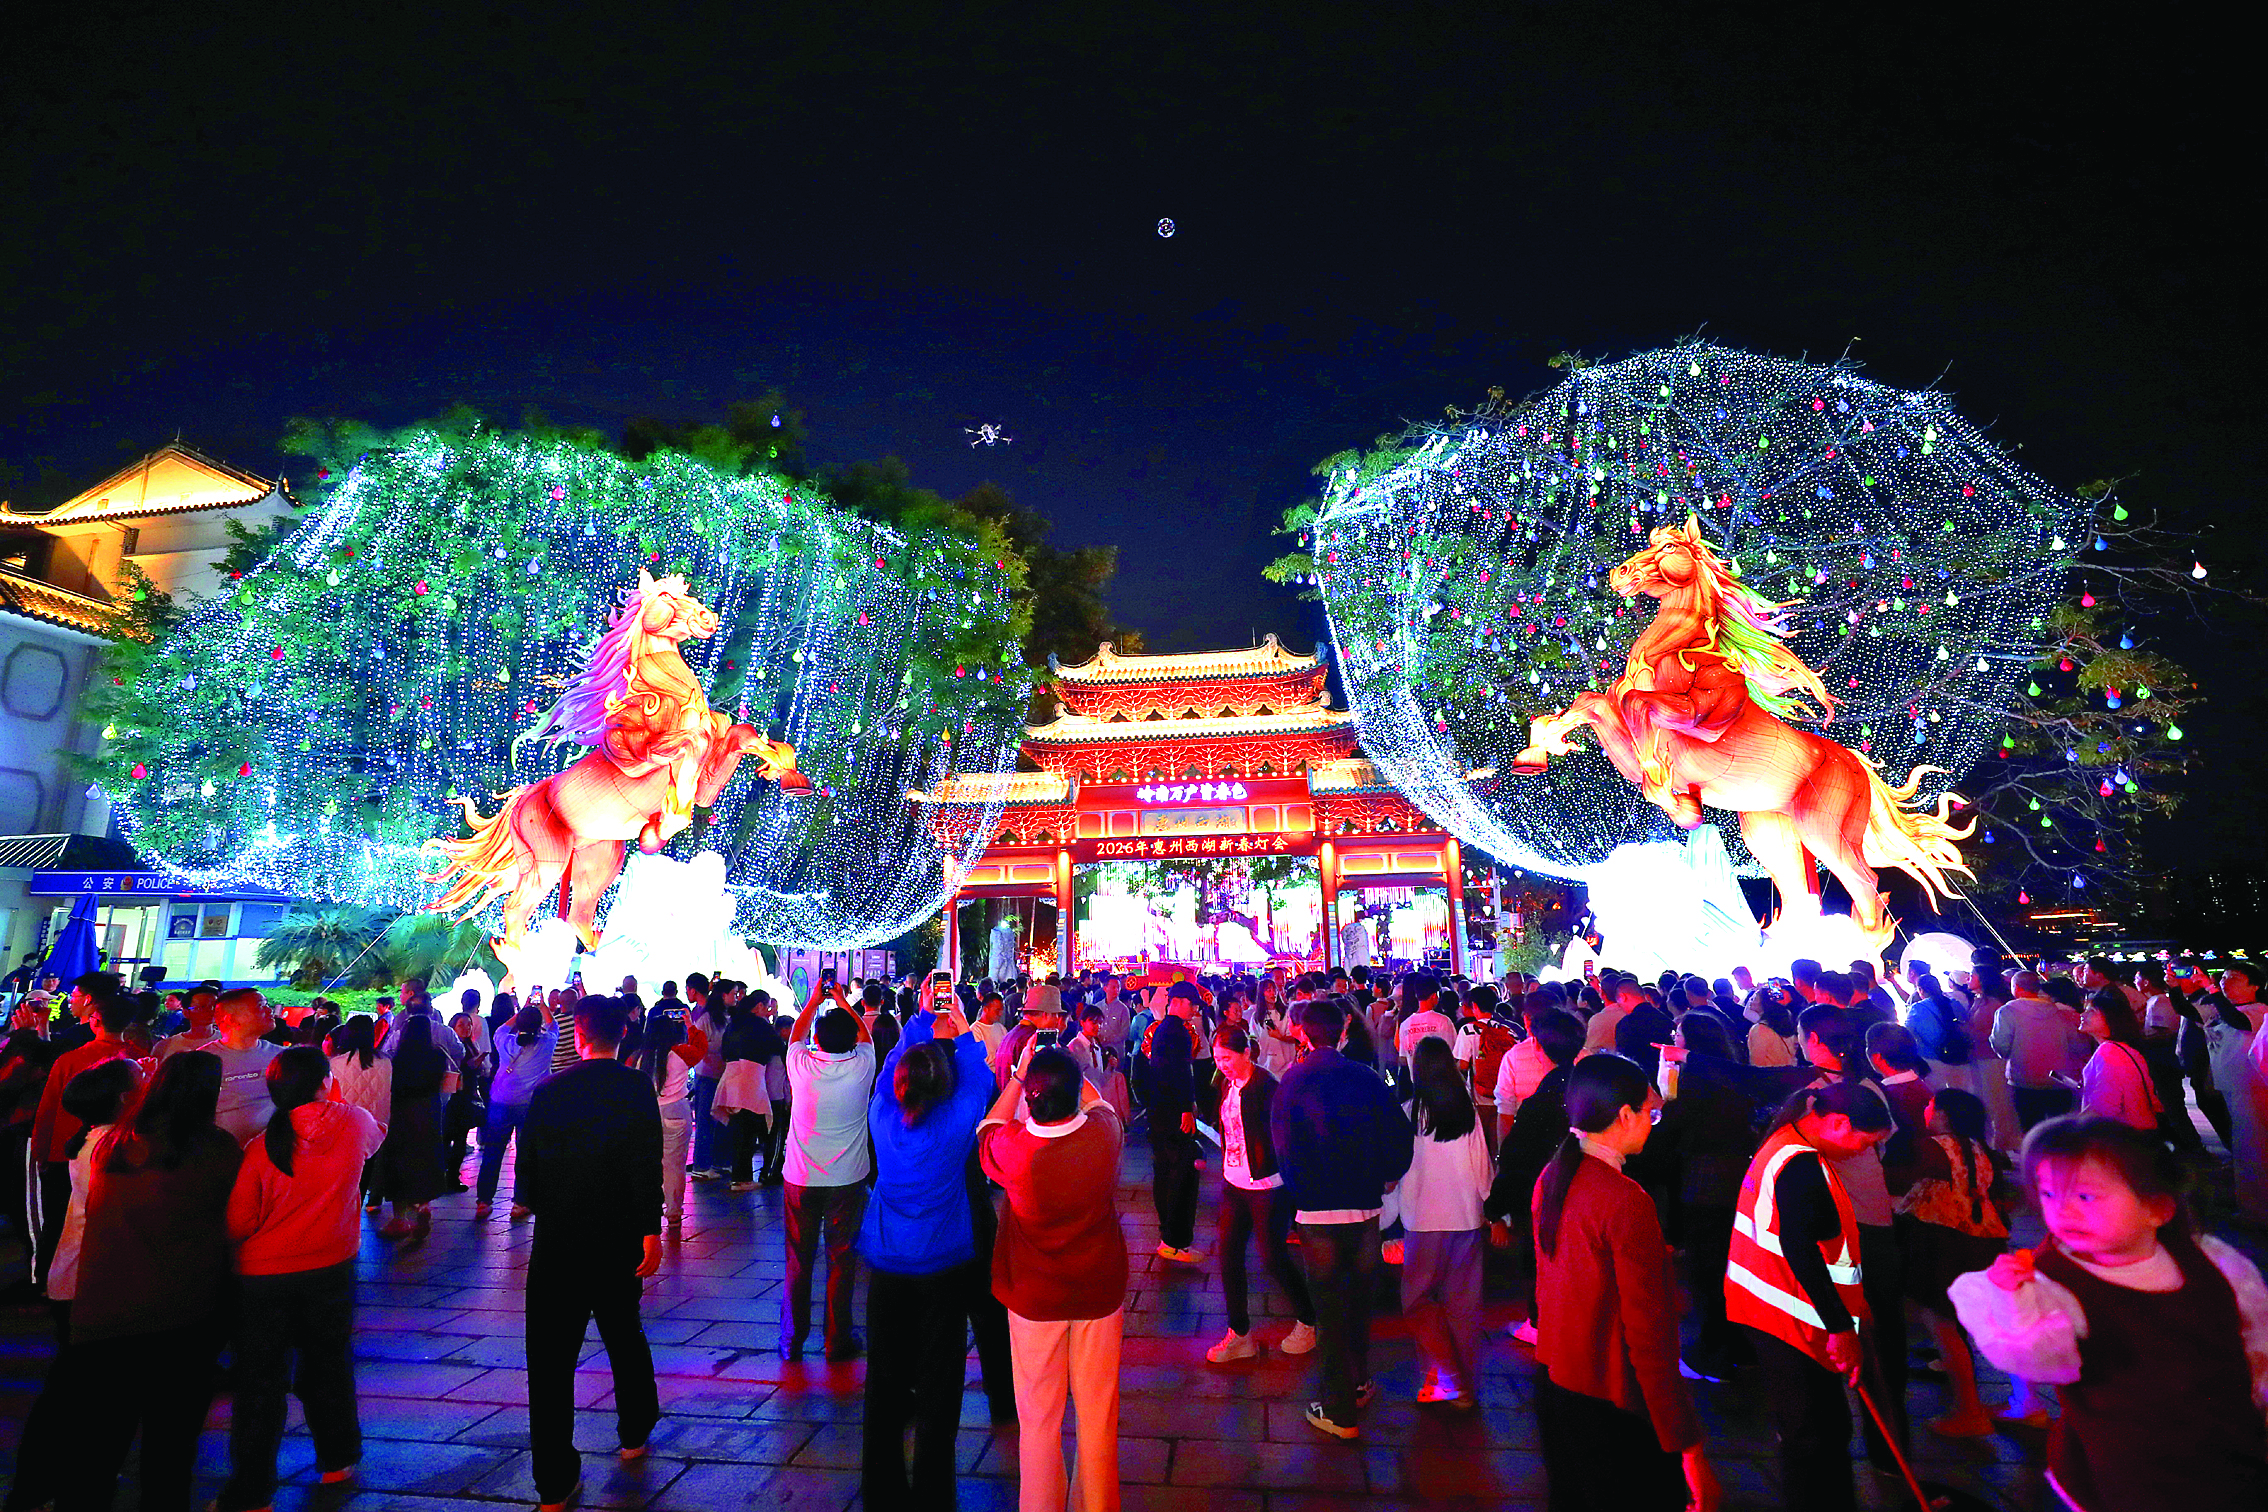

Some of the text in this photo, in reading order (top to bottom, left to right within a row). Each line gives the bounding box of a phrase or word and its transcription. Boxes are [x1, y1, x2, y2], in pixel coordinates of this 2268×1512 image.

[1153, 814, 1232, 832] 惠州西湖
[1096, 836, 1289, 856] 2026年惠州西湖新春灯会
[82, 876, 173, 890] 公安 POLICE
